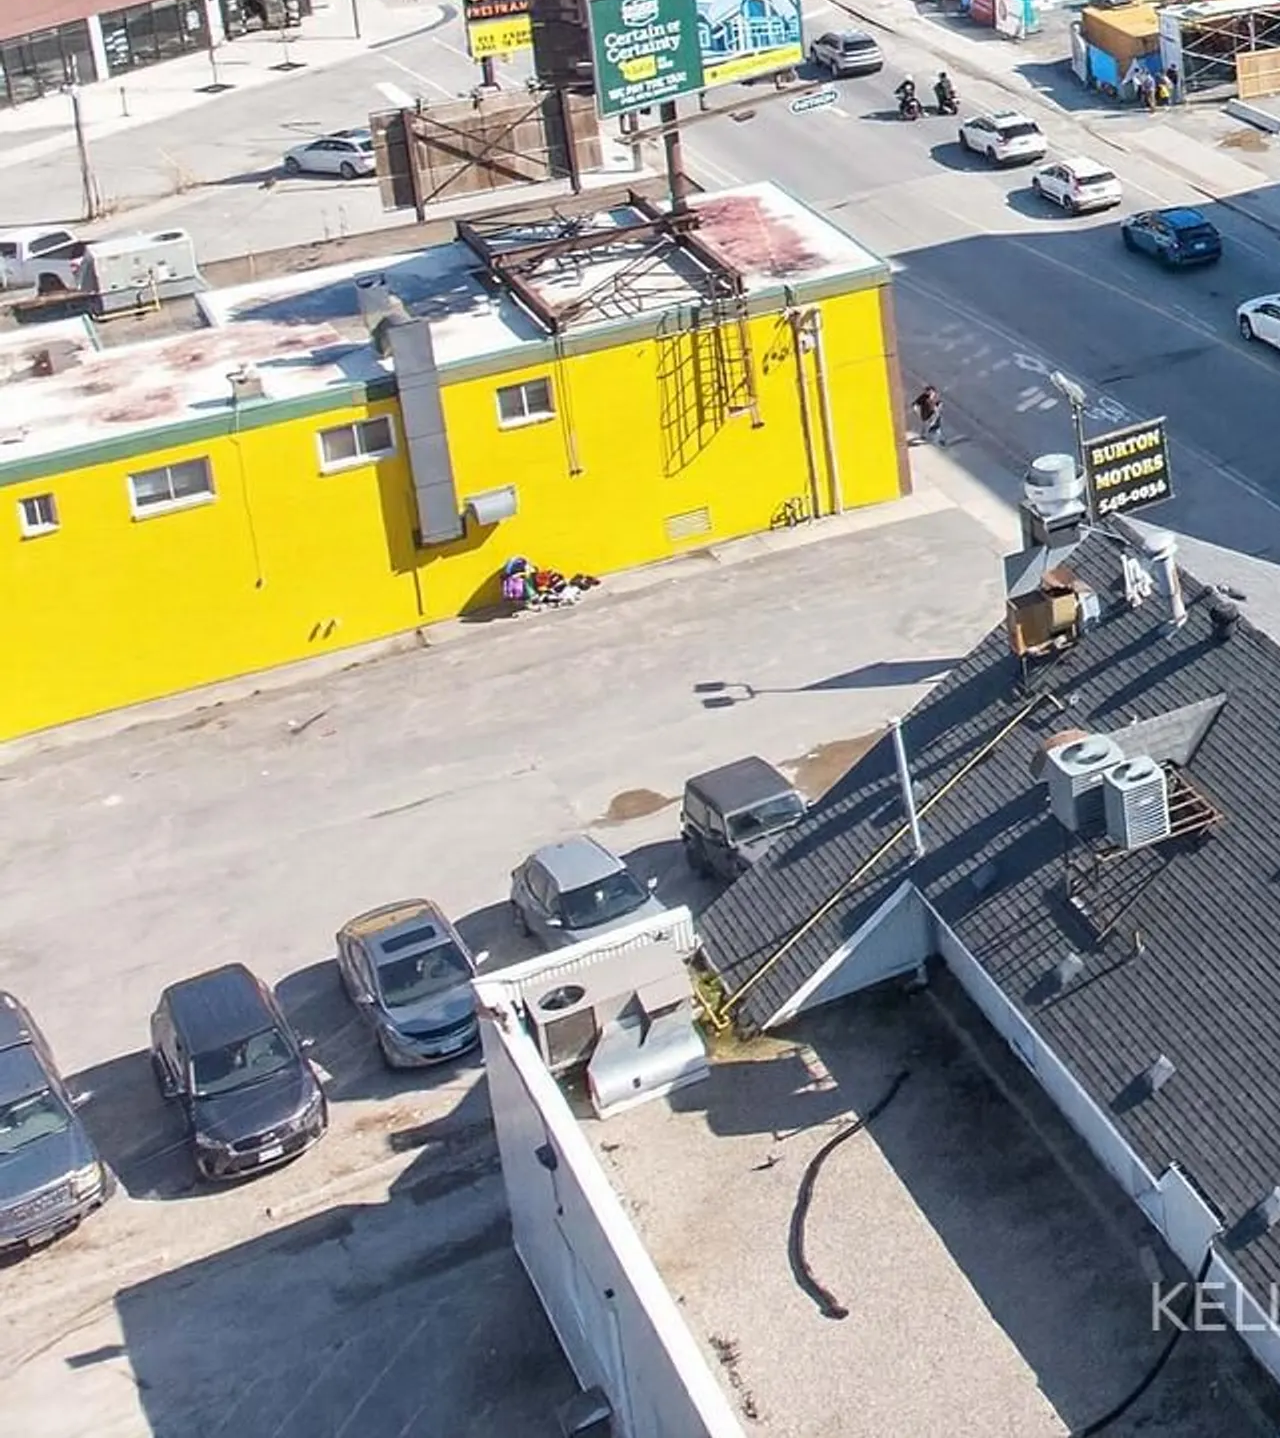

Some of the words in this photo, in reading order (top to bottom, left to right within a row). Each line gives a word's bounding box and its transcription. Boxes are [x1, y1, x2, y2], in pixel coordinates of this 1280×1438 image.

[604, 23, 665, 48] Certain
[606, 34, 682, 63] Certainty
[1092, 428, 1160, 465] BURTON
[1095, 453, 1164, 491] MOTORS
